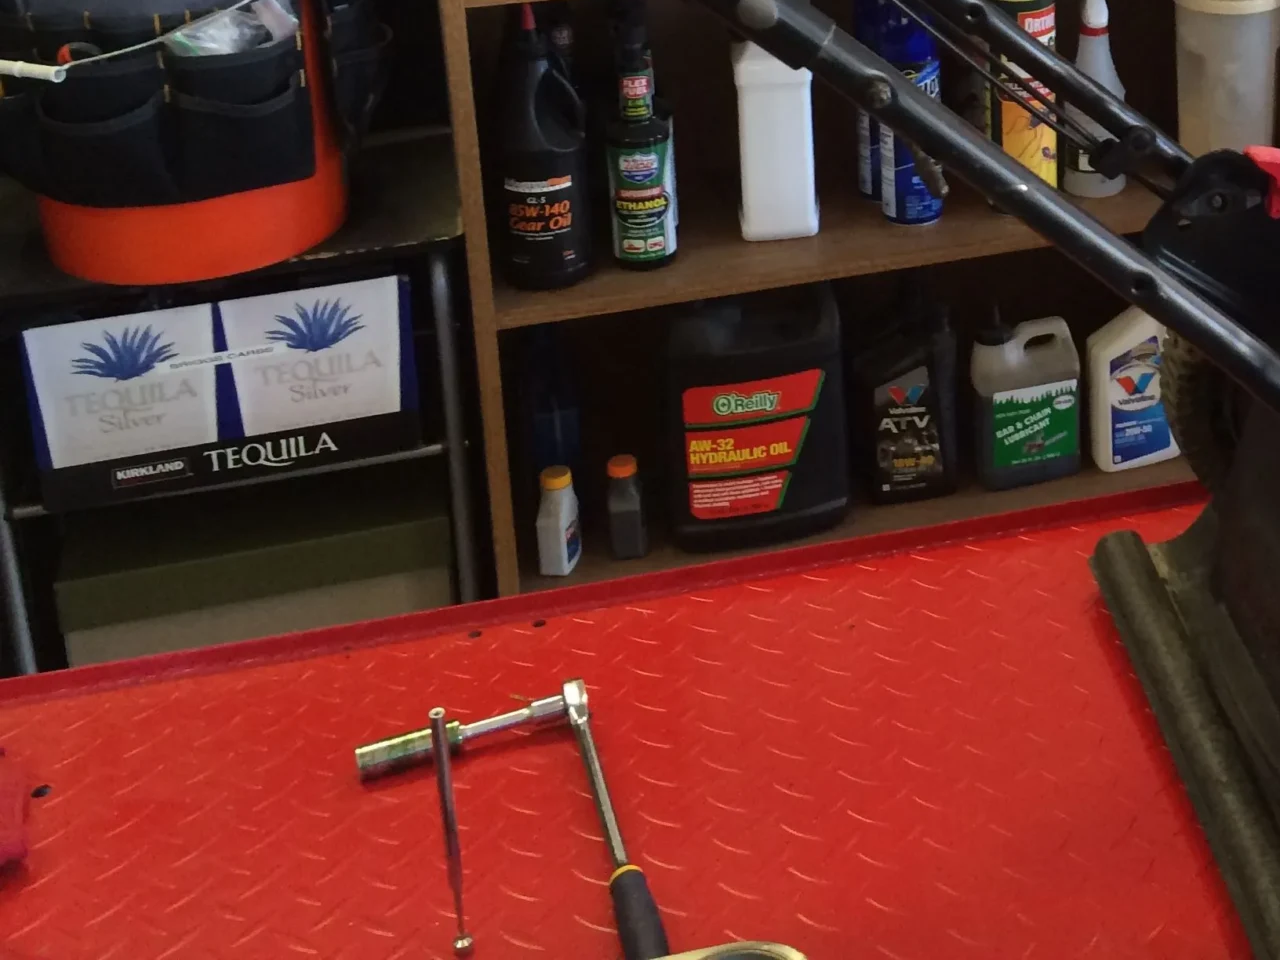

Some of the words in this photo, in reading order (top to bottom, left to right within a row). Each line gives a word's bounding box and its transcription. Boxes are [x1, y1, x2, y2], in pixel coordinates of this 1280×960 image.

[616, 196, 667, 210] ETHANOL
[510, 217, 545, 231] Gear
[549, 212, 572, 230] Oil
[255, 349, 384, 387] TEQUILA
[64, 378, 198, 417] TEQUILA
[289, 382, 354, 404] Silver
[715, 393, 778, 414] O'Reilly
[98, 409, 164, 434] Silver
[878, 414, 931, 433] ATV
[1004, 417, 1050, 445] LUBRICANT
[203, 431, 338, 472] TEQUILA
[690, 438, 734, 452] AW-32
[690, 446, 767, 464] HYDRAULIC
[770, 441, 792, 456] OIL
[116, 460, 185, 480] KIRKLAND
